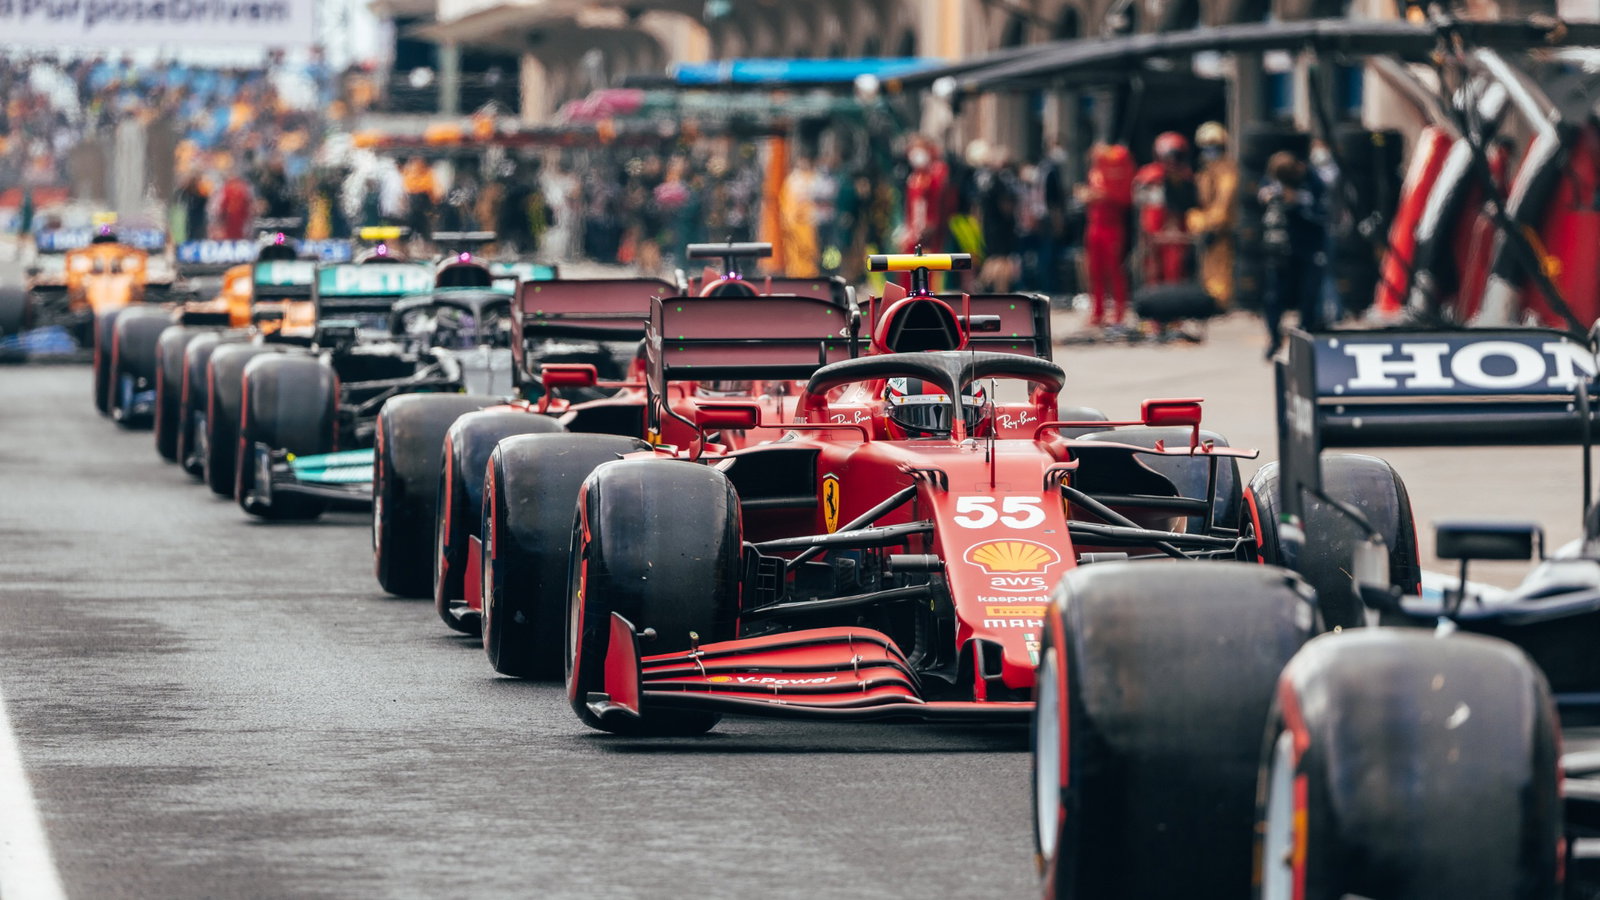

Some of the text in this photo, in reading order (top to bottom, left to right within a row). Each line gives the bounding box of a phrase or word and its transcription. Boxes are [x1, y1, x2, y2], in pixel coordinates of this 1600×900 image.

[953, 496, 1046, 530] 55
[991, 577, 1045, 586] aws
[737, 676, 836, 684] V-Power
